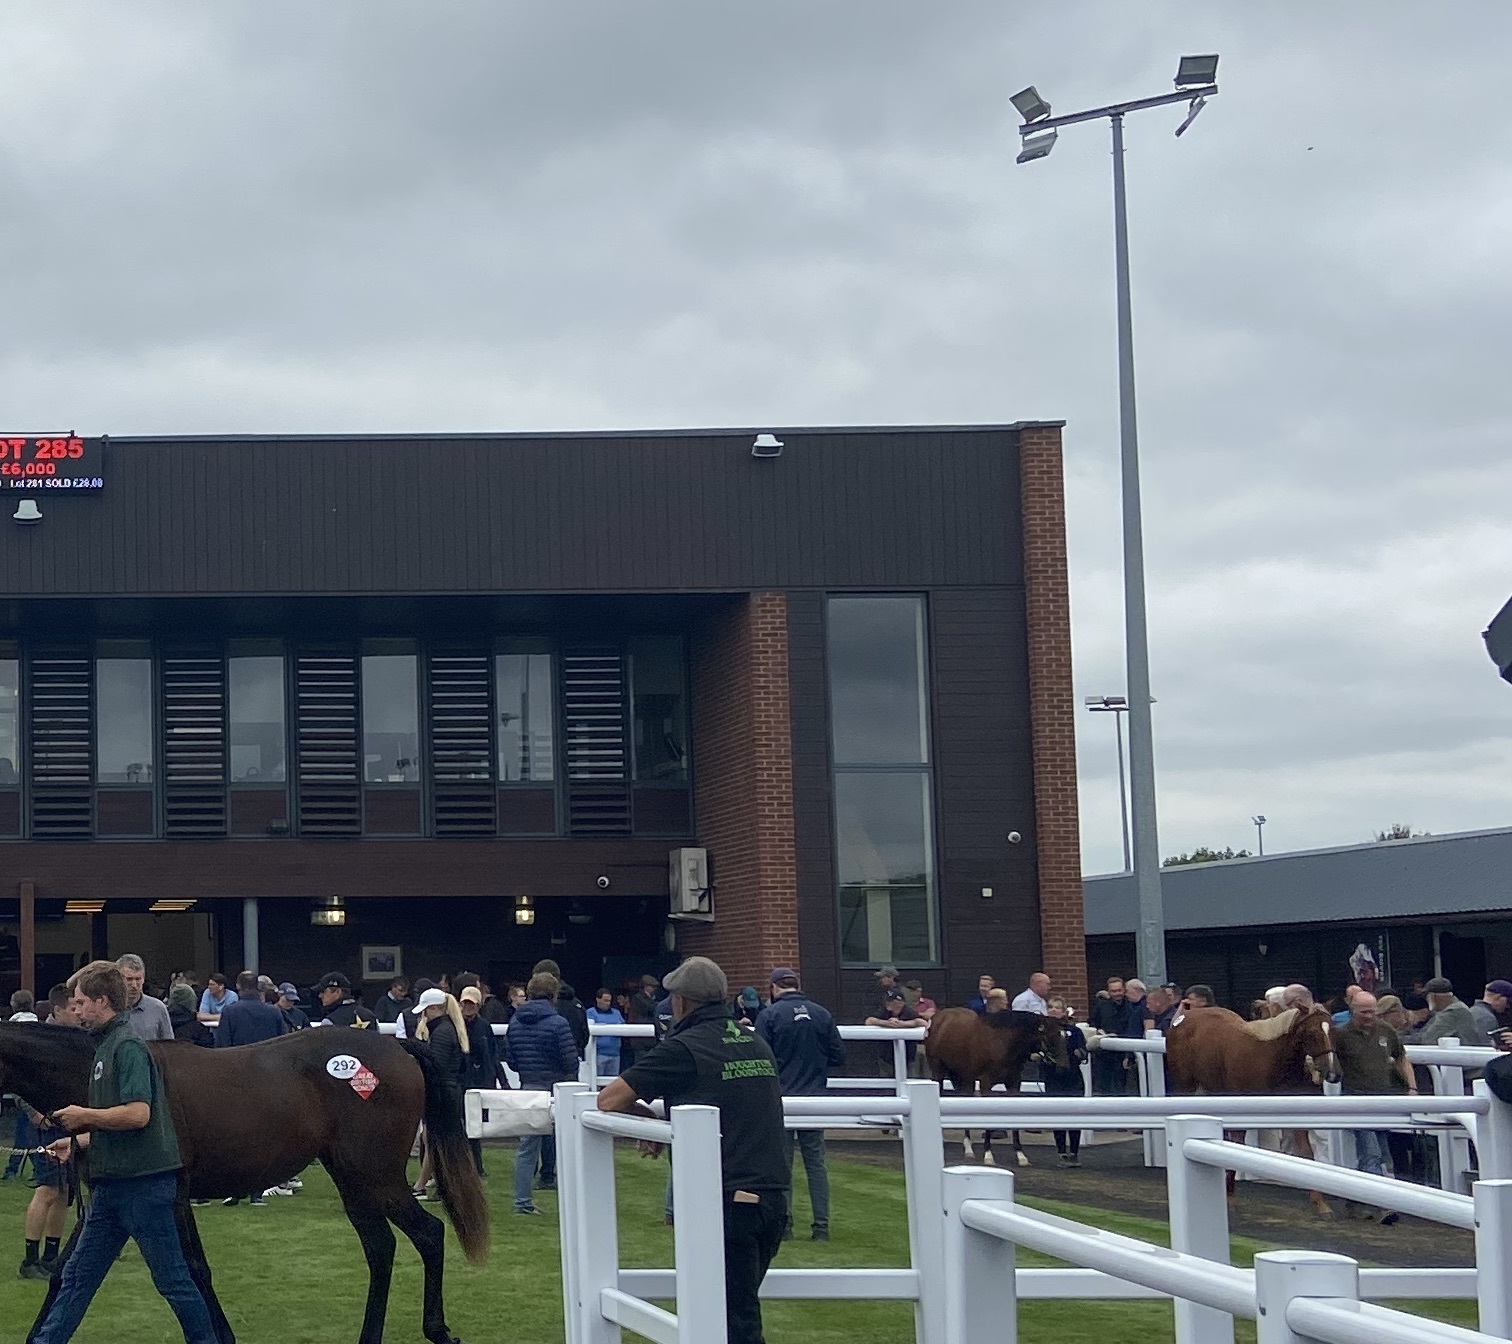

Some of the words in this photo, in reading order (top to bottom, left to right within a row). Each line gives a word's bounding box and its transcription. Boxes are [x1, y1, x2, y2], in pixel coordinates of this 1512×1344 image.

[35, 439, 84, 460] 285
[0, 463, 56, 478] £6,000
[45, 478, 71, 488] SOLD
[332, 1059, 356, 1072] 292
